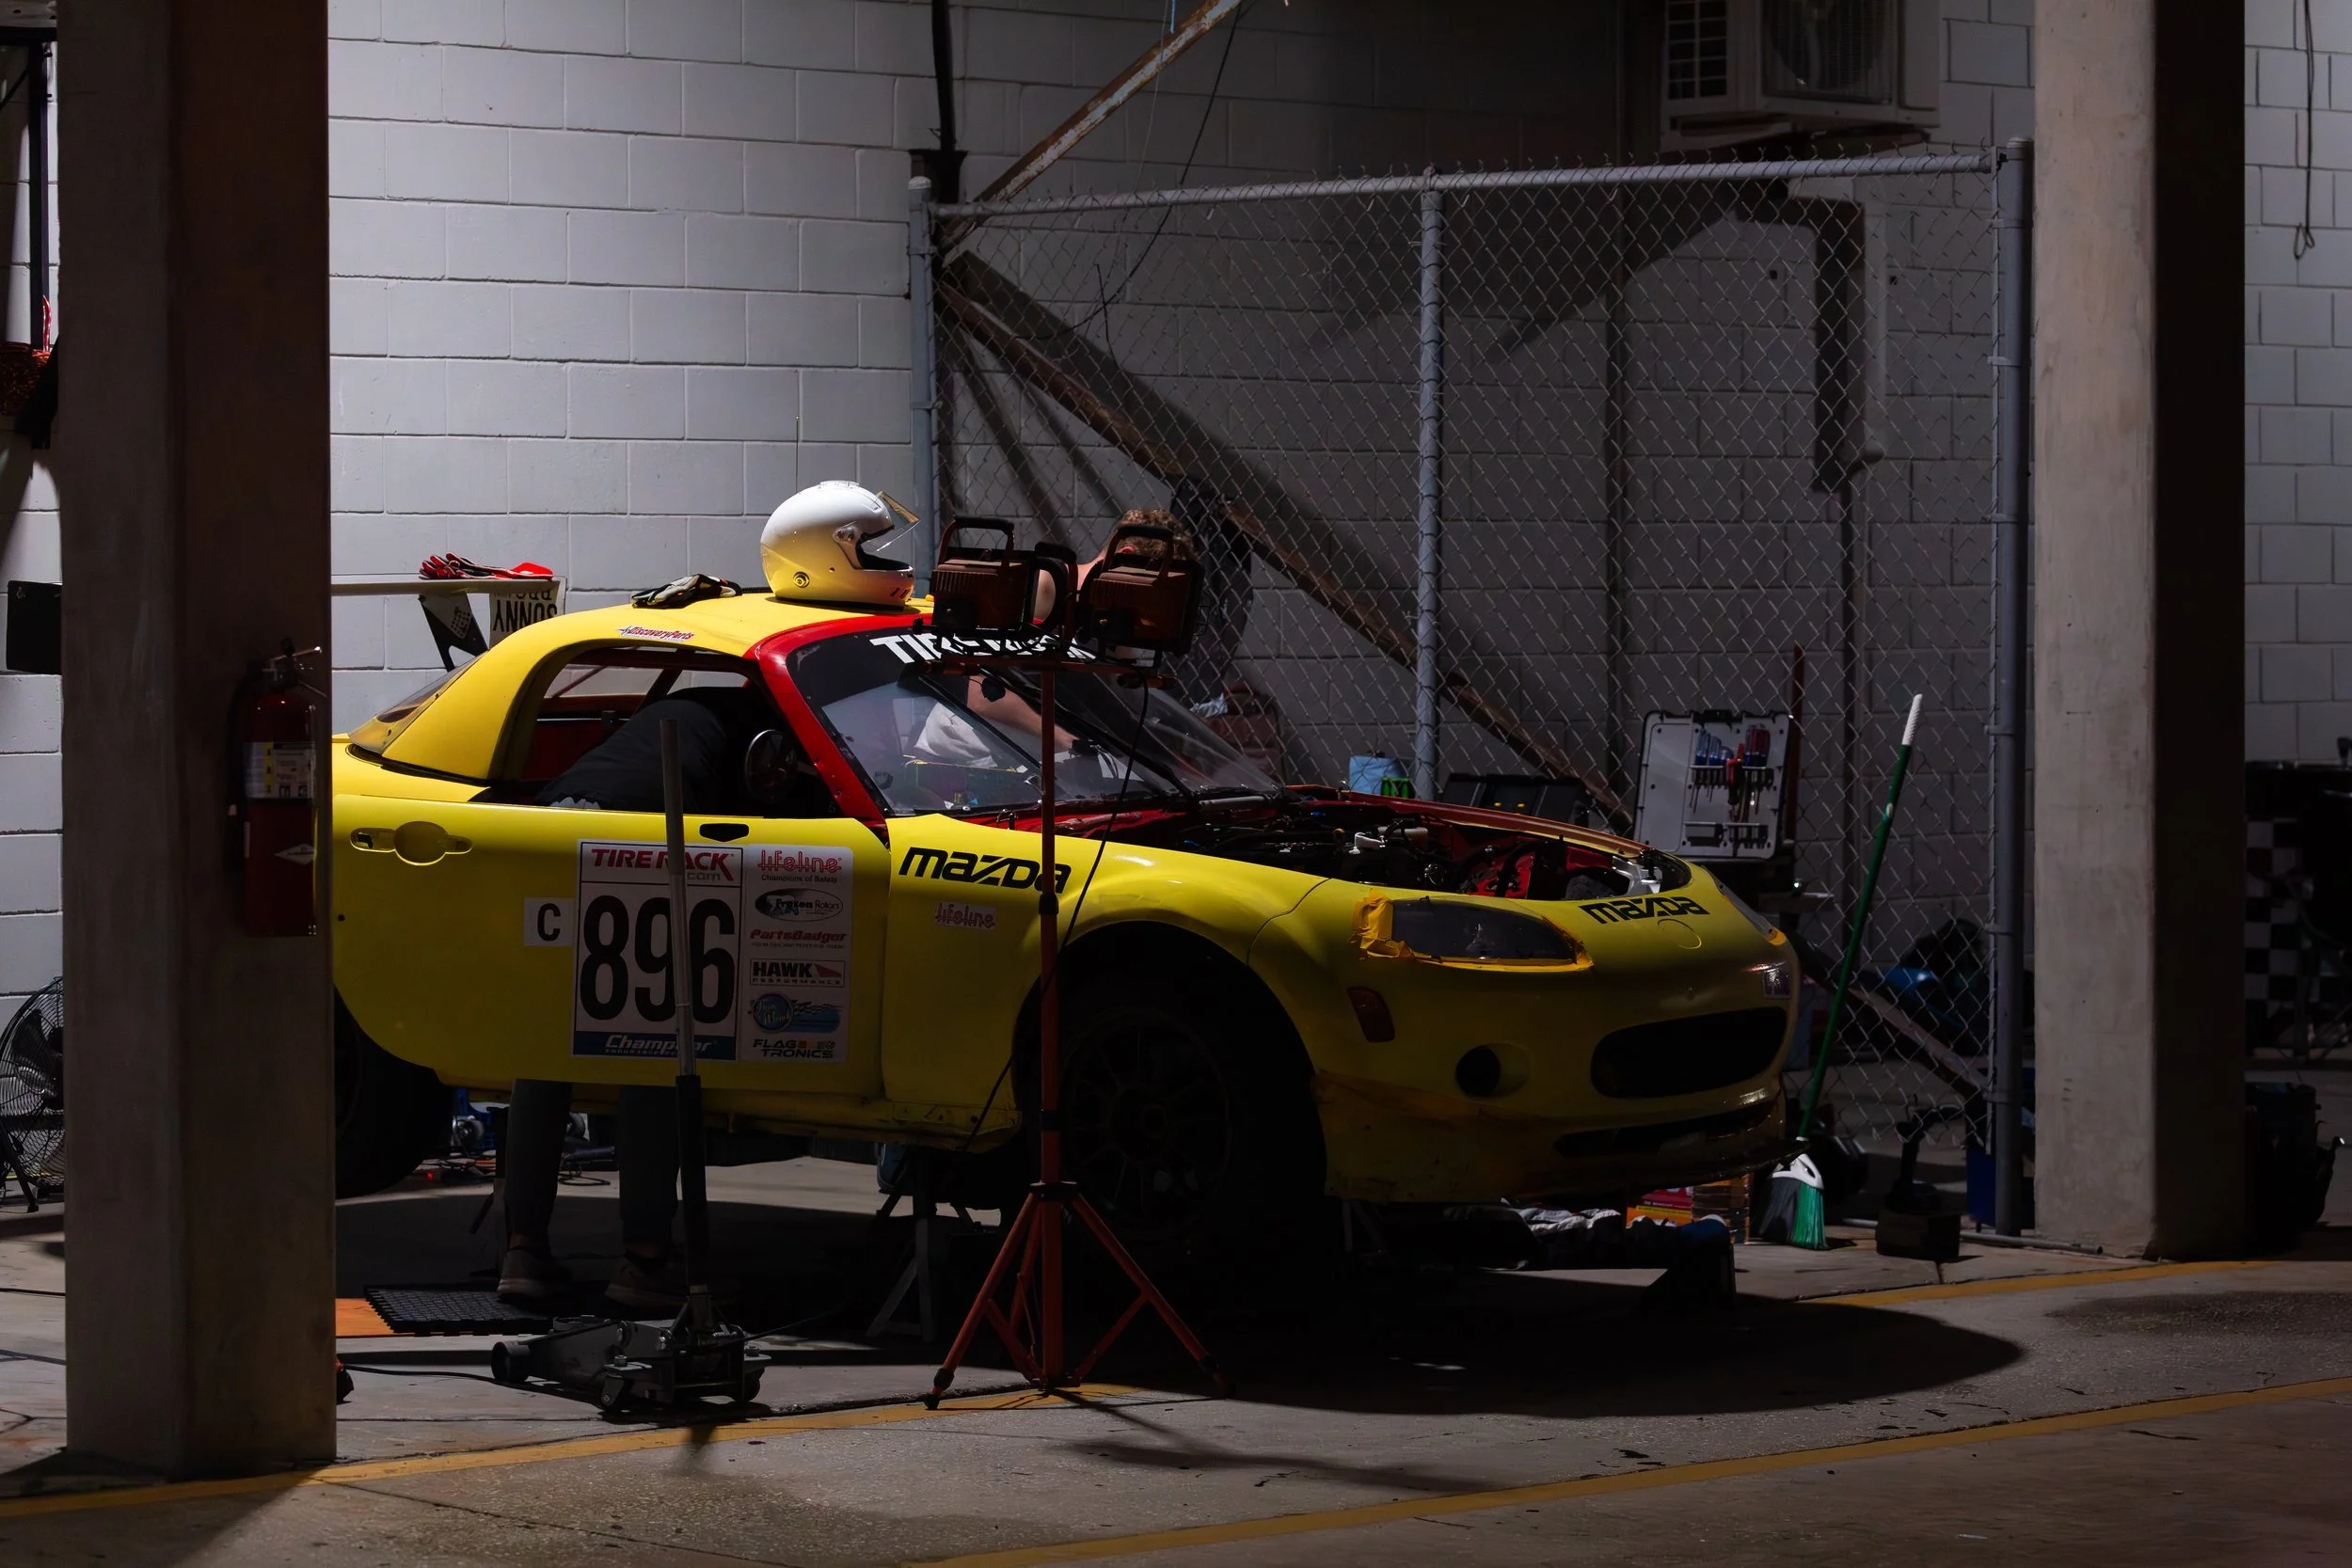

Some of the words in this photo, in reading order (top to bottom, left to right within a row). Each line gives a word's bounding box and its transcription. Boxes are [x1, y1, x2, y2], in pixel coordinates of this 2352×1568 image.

[592, 848, 653, 869] TIRE
[757, 849, 841, 874] lifeline
[761, 875, 803, 883] Champions
[814, 876, 838, 884] Safety
[537, 903, 561, 942] C
[580, 895, 735, 1024] 896
[753, 961, 813, 977] HAWK
[753, 1038, 797, 1049] FLAG
[761, 1049, 834, 1058] TRONICS
